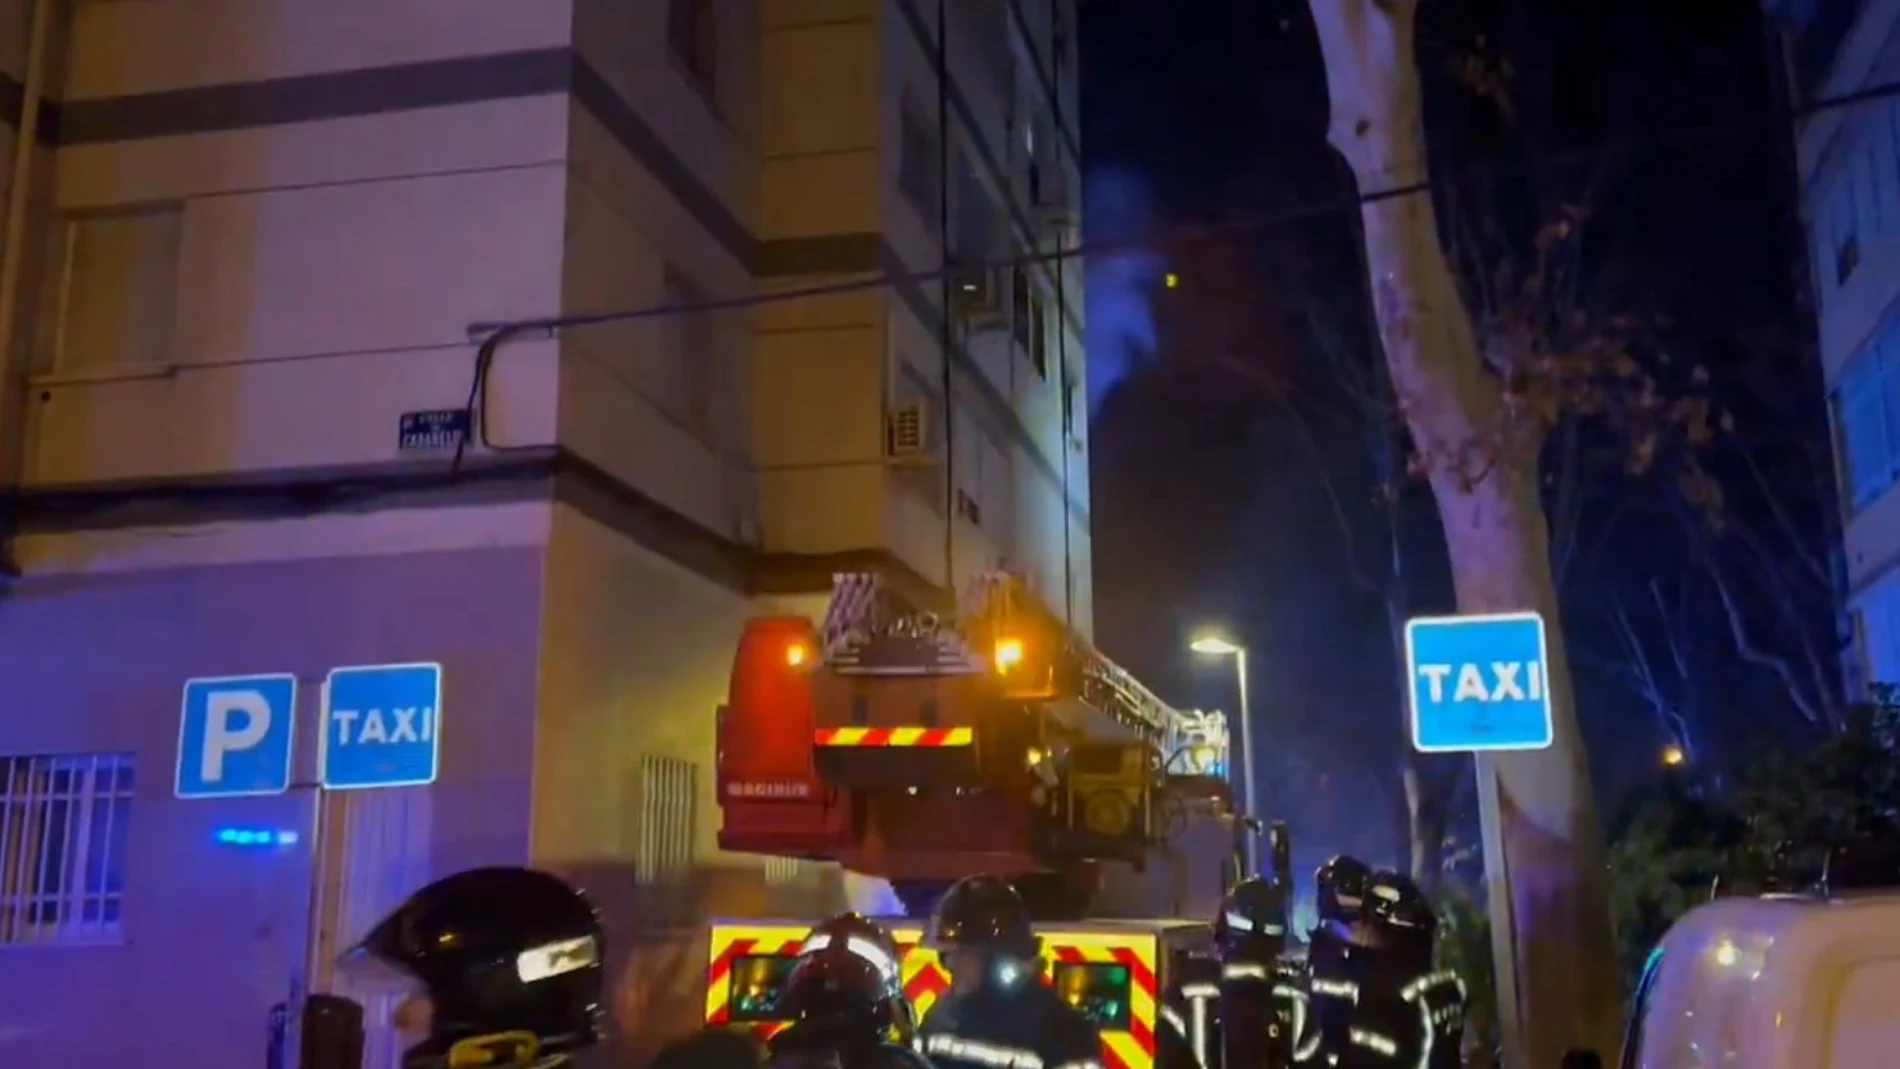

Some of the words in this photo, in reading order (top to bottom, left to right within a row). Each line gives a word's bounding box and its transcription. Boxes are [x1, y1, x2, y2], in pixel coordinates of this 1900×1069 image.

[1418, 660, 1541, 703] TAXI
[201, 690, 272, 782] P
[332, 706, 432, 746] TAXI
